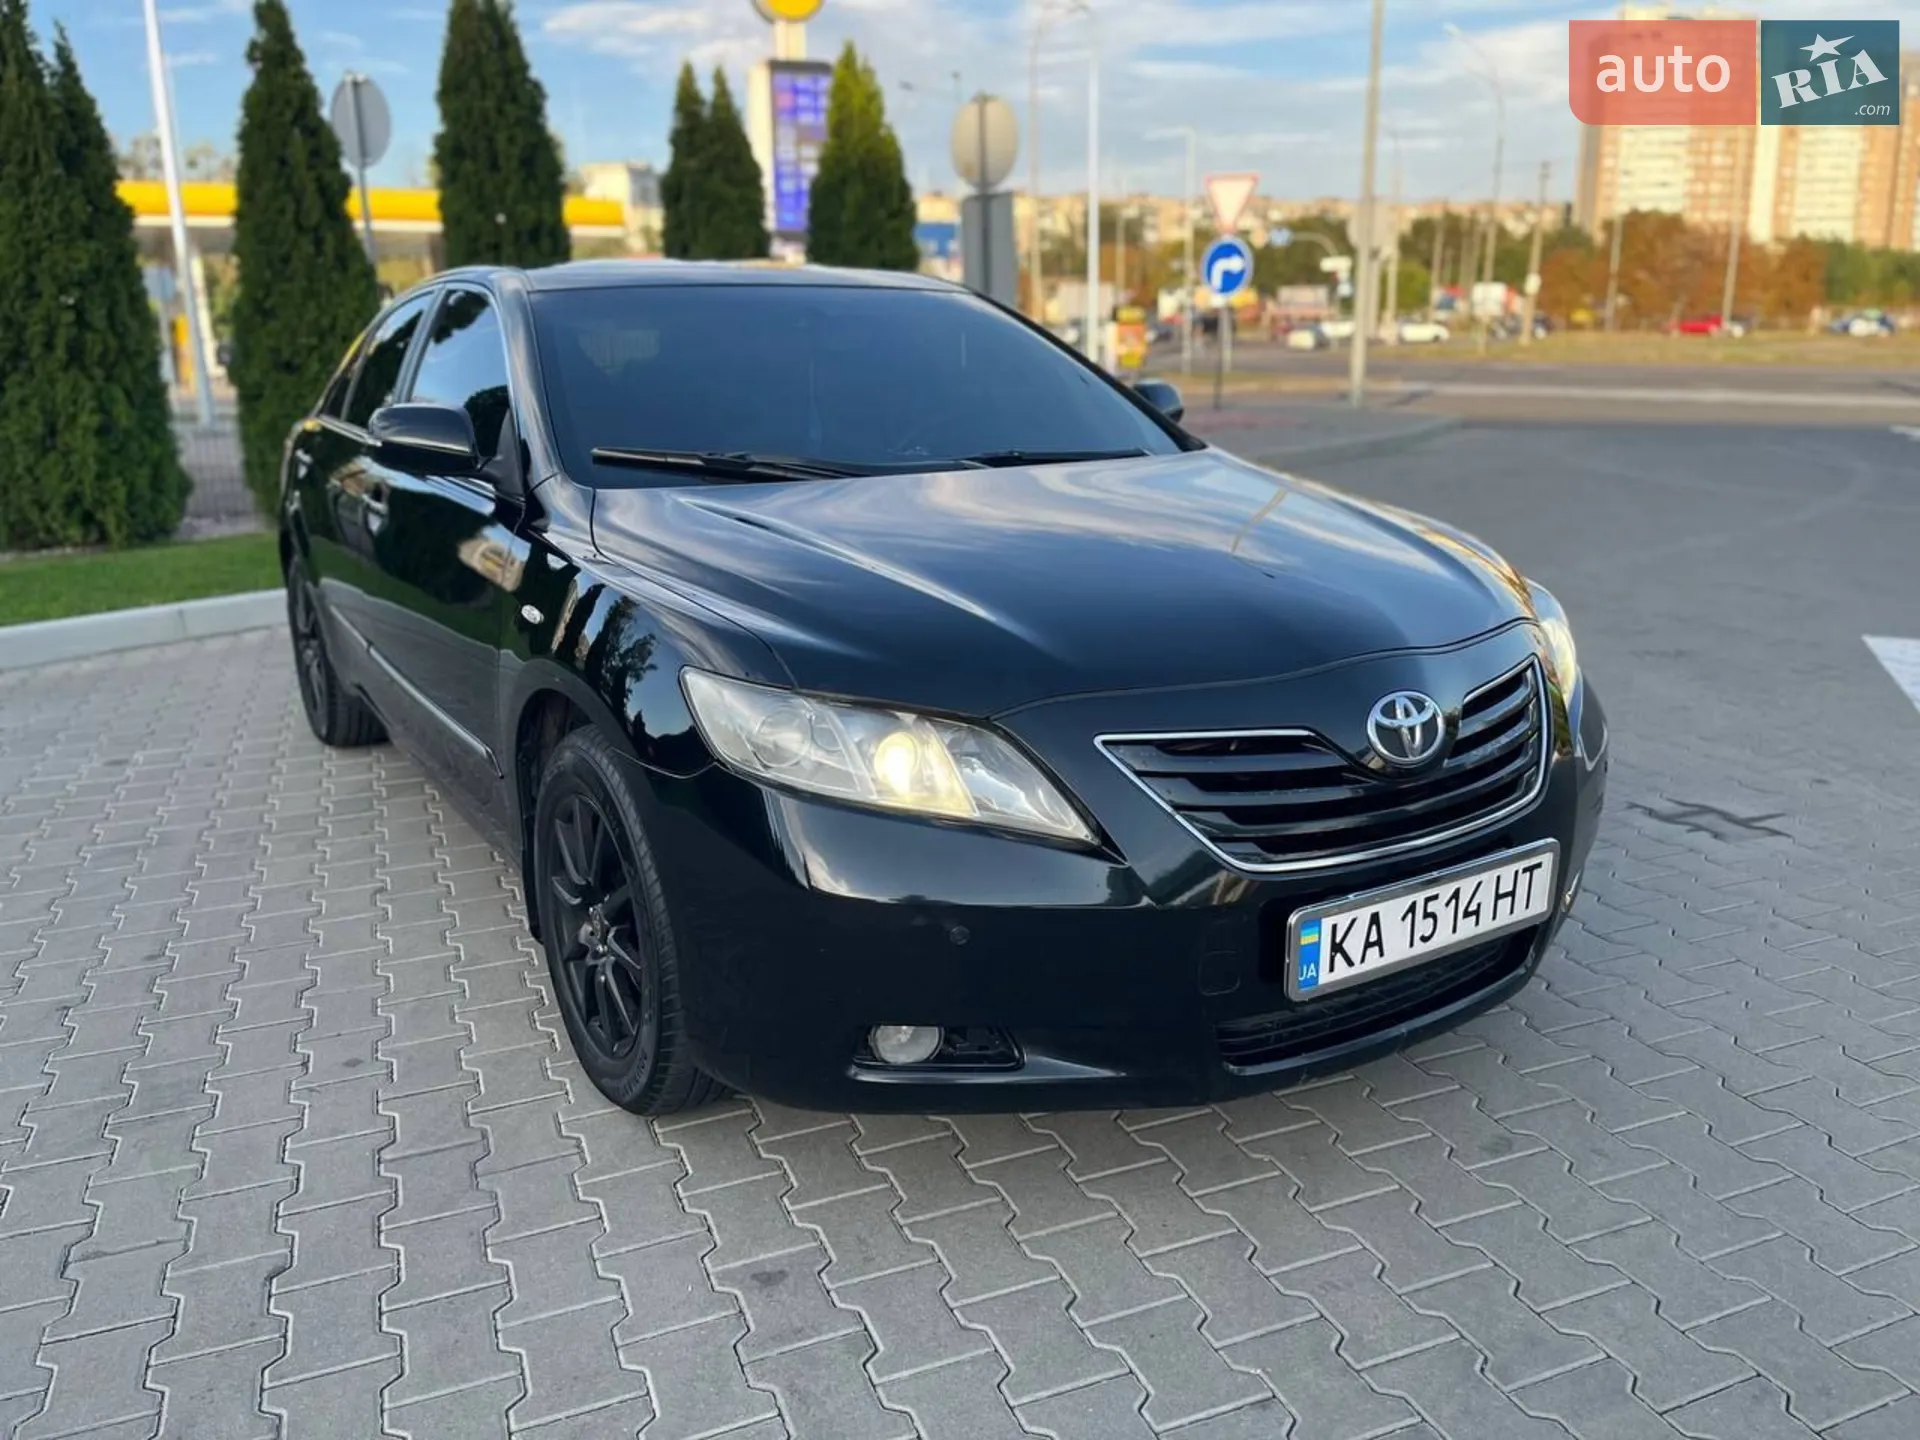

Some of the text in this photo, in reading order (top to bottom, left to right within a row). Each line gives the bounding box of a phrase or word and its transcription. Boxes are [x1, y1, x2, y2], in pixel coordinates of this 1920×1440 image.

[1328, 862, 1543, 973] KA 1514 HT
